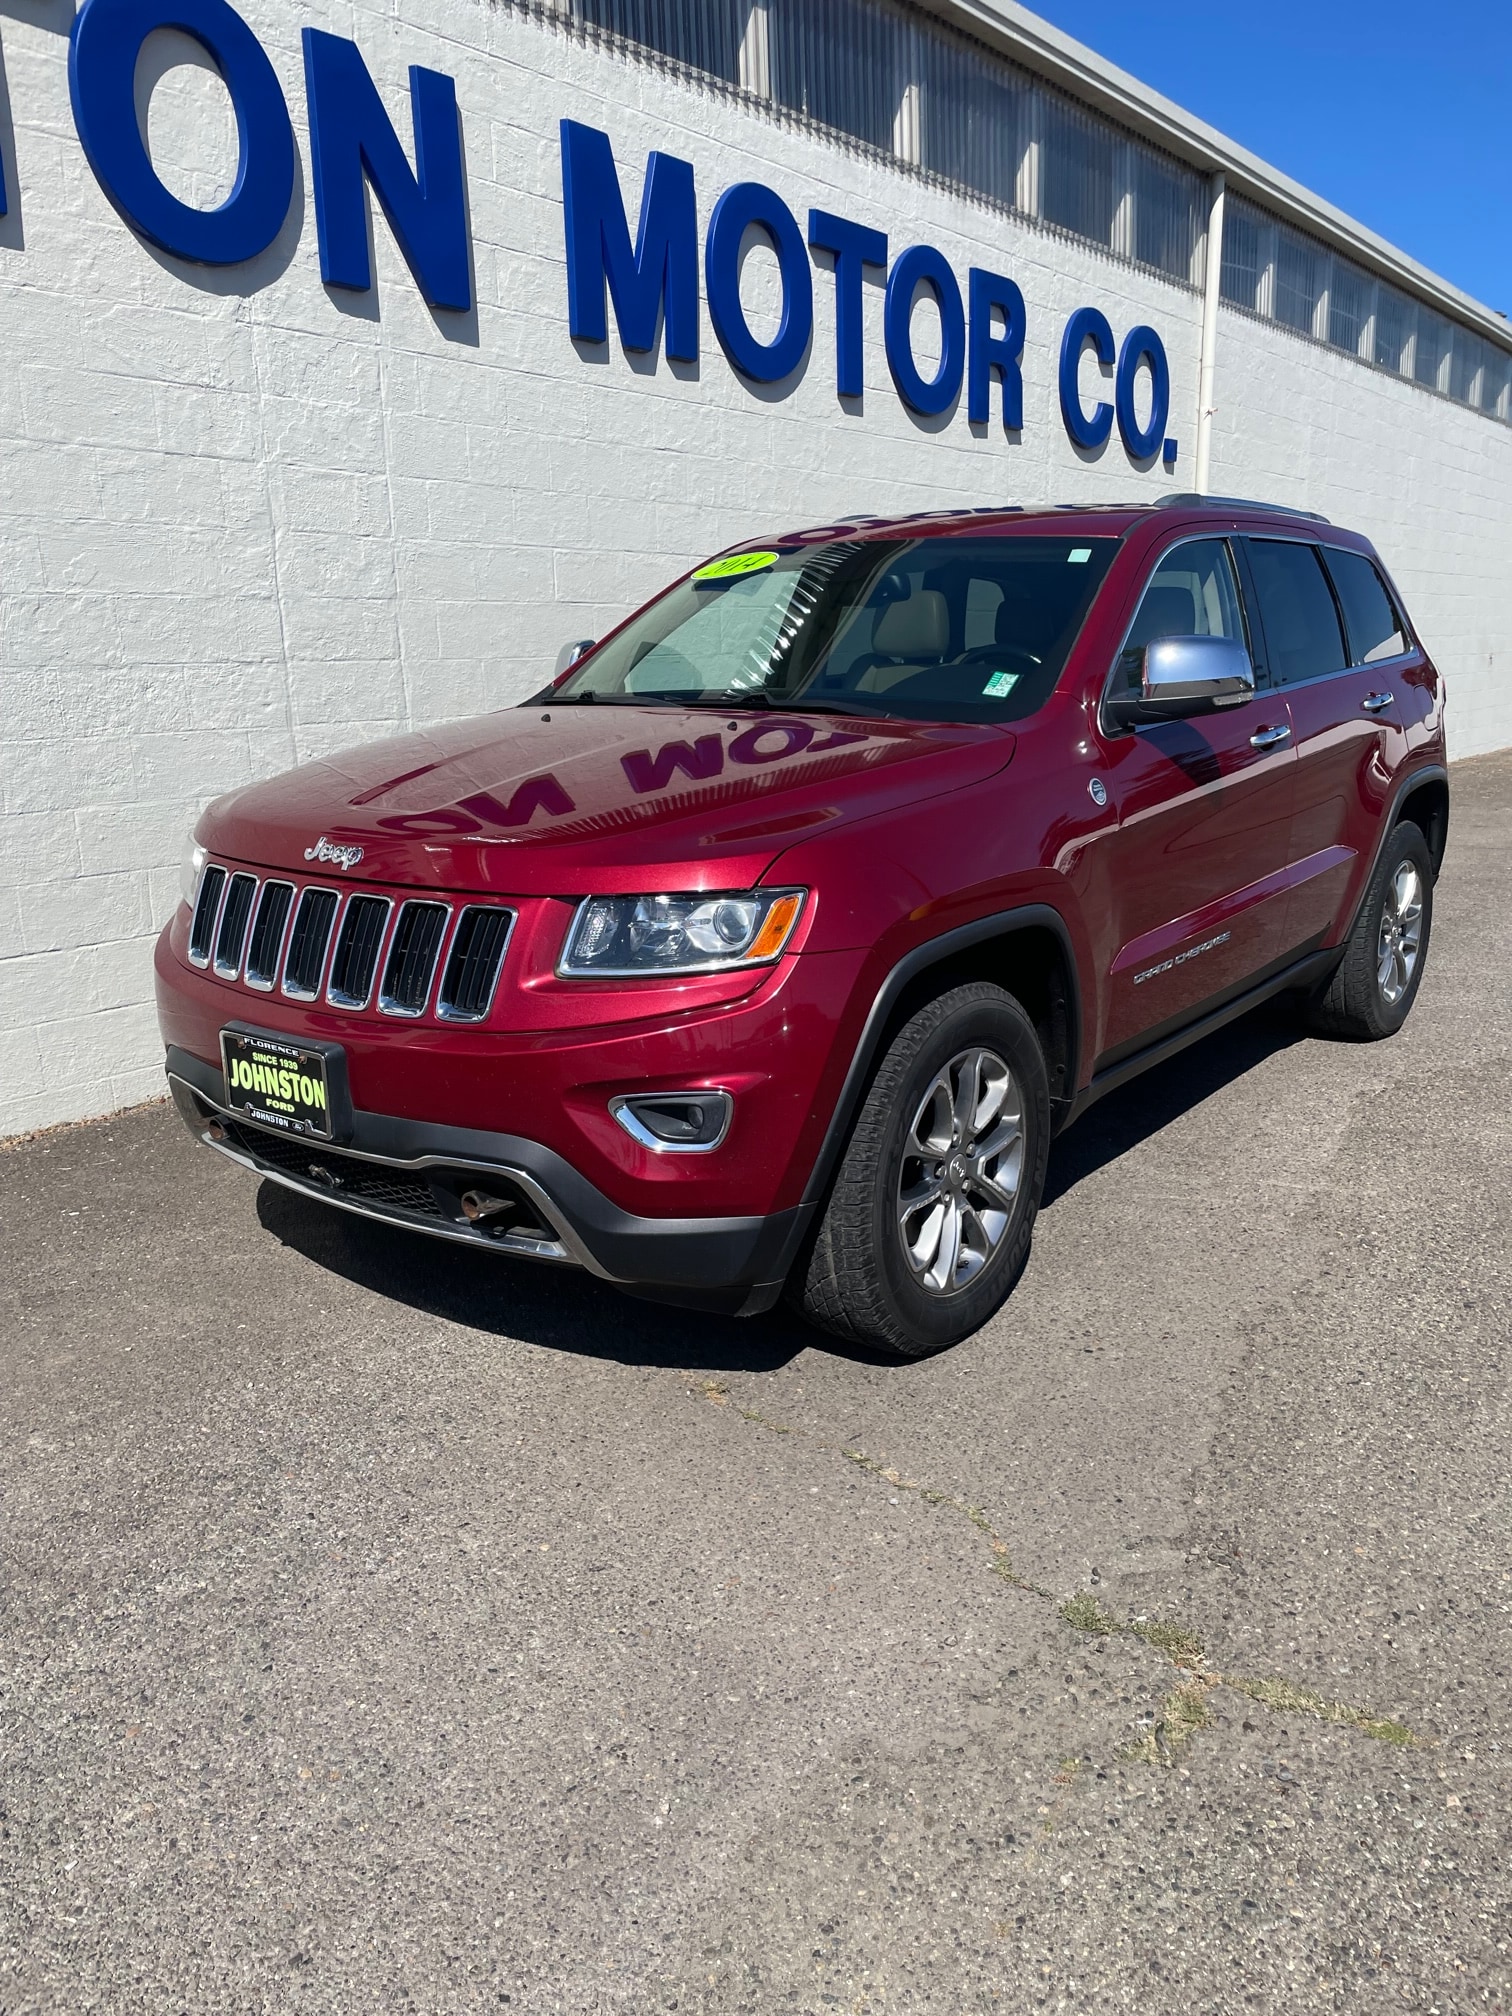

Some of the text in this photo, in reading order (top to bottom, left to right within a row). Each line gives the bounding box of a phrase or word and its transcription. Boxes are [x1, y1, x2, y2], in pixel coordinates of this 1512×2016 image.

[0, 0, 1178, 463] ON MOTOR CO.
[304, 836, 364, 871] Jeep
[1133, 931, 1232, 985] GRAND CHEROKEE
[243, 1038, 300, 1057] FLORENCE
[252, 1052, 299, 1071] SINCE 1939
[231, 1058, 326, 1110] JOHNSTON
[251, 1110, 289, 1127] JOHNSTON
[265, 1098, 296, 1113] FORD
